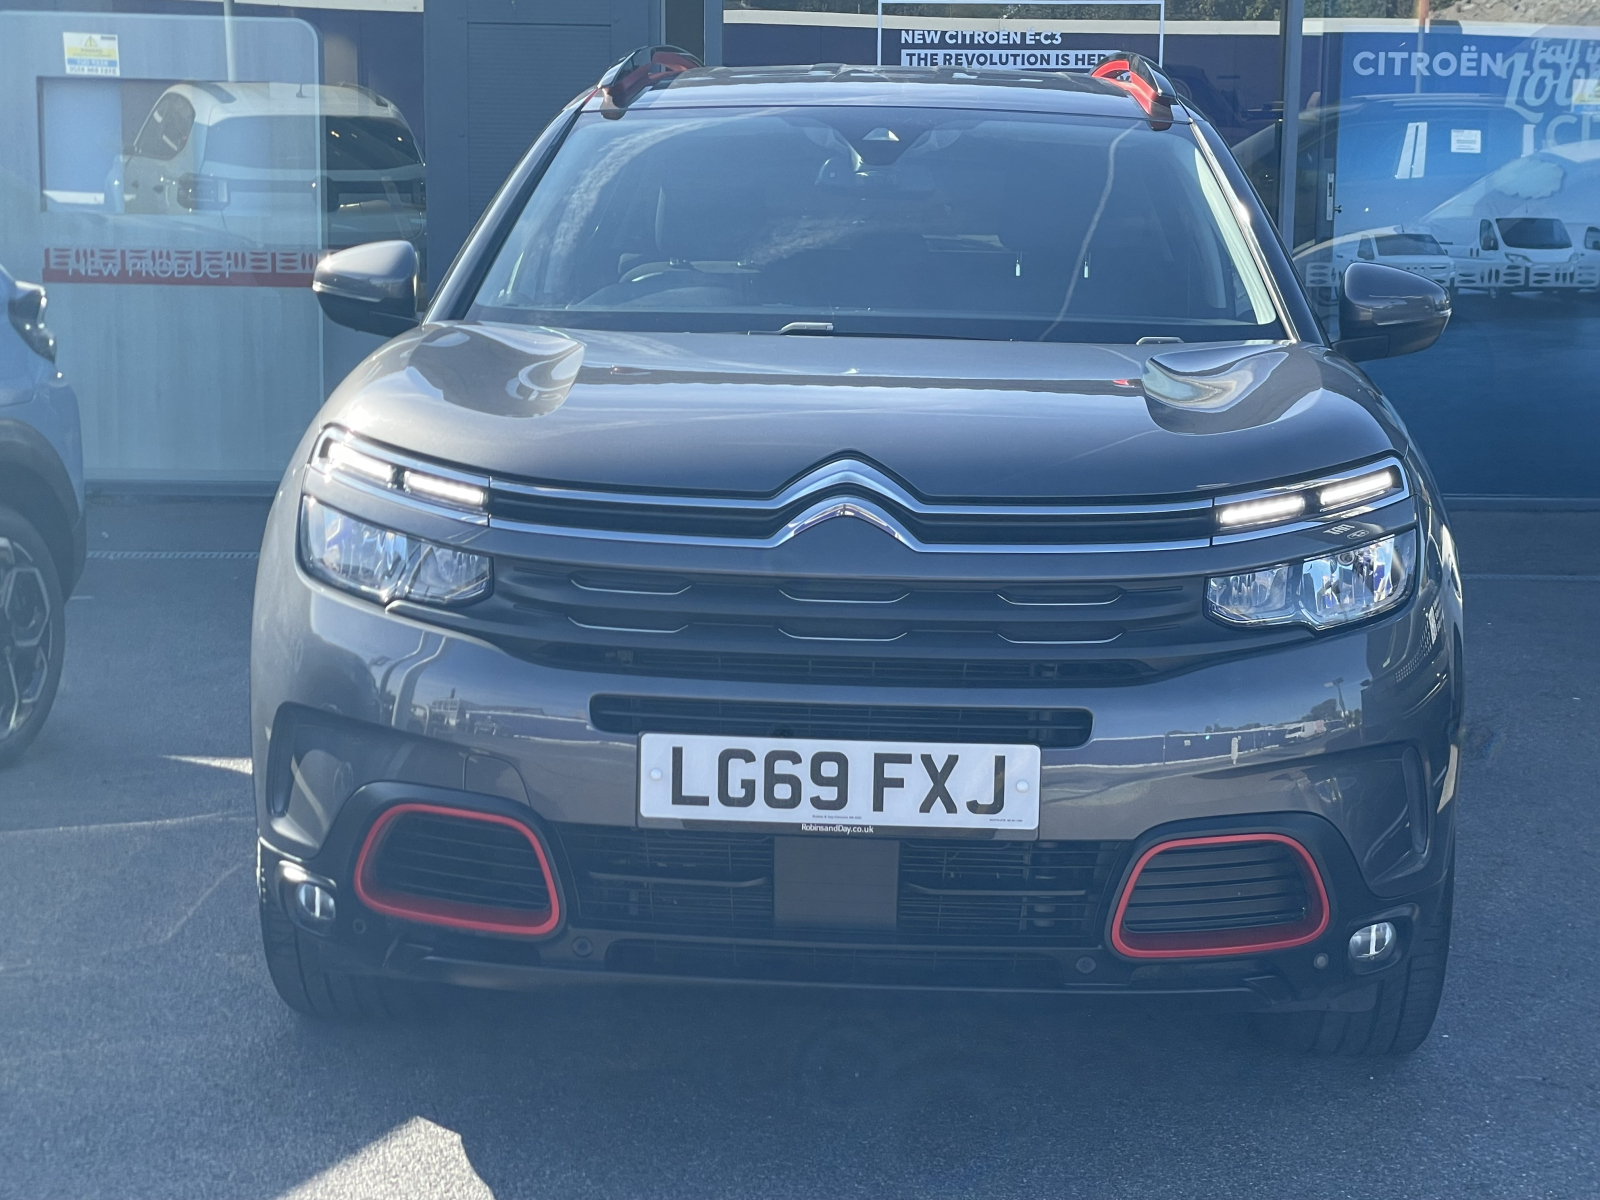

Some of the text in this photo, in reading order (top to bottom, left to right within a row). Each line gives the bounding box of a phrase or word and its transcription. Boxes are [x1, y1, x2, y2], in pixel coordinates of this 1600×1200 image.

[900, 30, 941, 44] NEW
[906, 53, 939, 67] THE
[943, 53, 1051, 67] REVOLUTION
[1055, 54, 1071, 66] IS
[1353, 45, 1504, 77] CITROËN
[68, 258, 232, 279] NEW PRODUCT
[671, 746, 1006, 815] LG69 FXJ
[801, 823, 874, 835] RobinsandDay.co.uk
